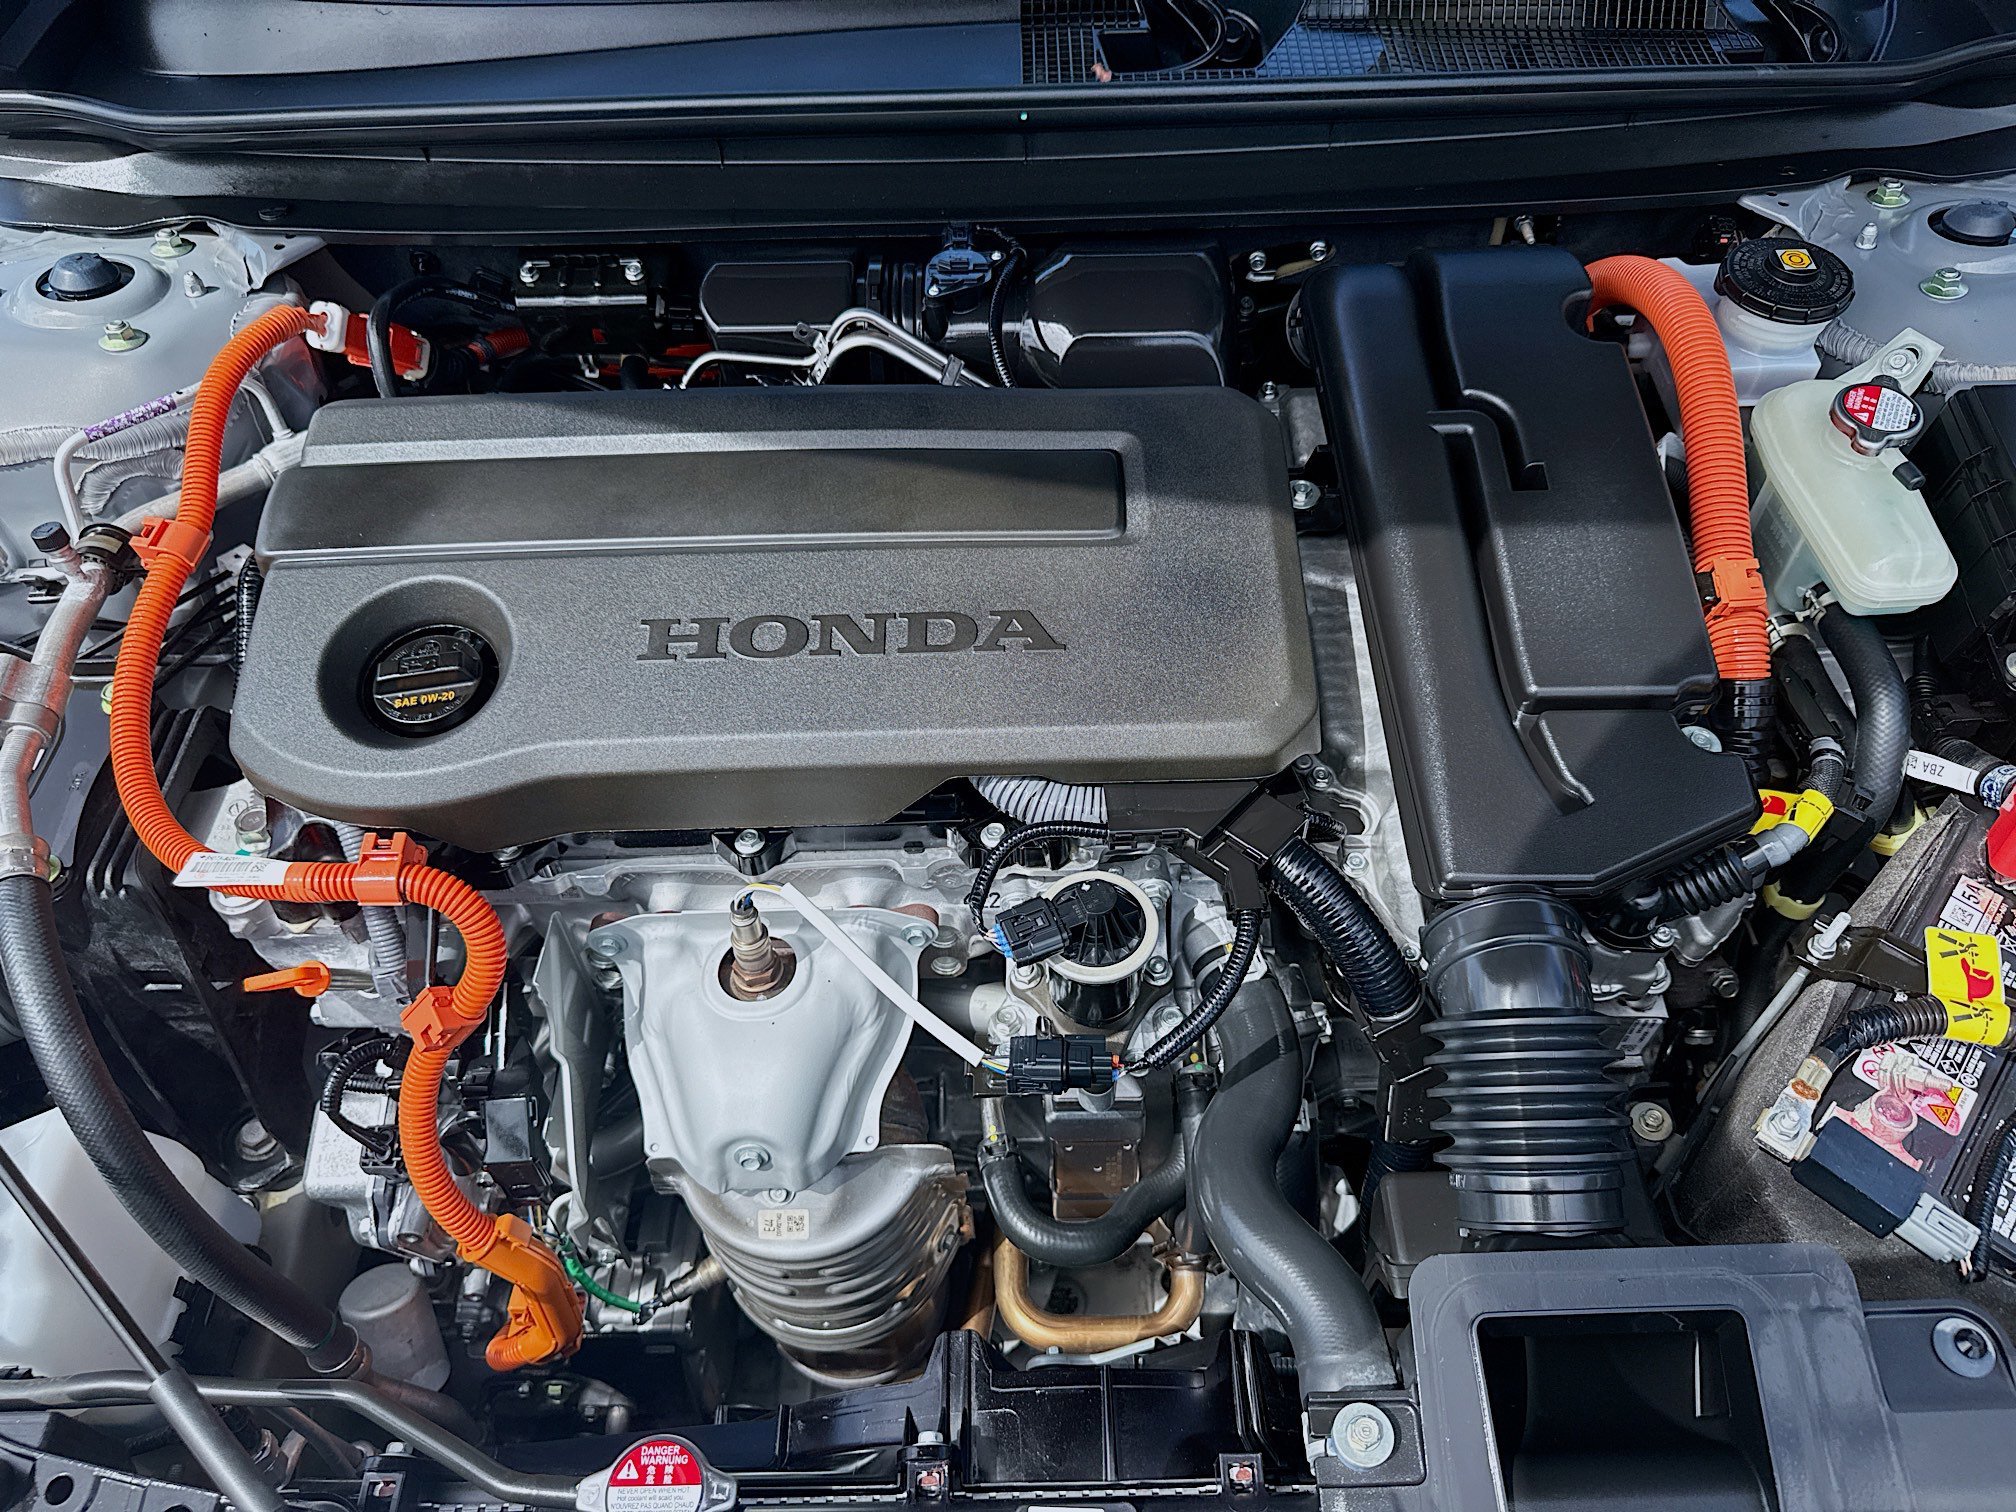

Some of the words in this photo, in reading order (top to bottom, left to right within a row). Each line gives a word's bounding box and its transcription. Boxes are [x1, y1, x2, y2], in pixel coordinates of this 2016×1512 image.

[636, 609, 1067, 662] HONDA
[394, 696, 418, 709] SAE
[420, 690, 455, 705] 0W-20
[1922, 761, 1945, 778] ZBA
[641, 1446, 680, 1455] DANGER
[640, 1455, 688, 1465] WARNUNG
[652, 1501, 674, 1509] QUAND
[674, 1501, 695, 1509] CHAUD
